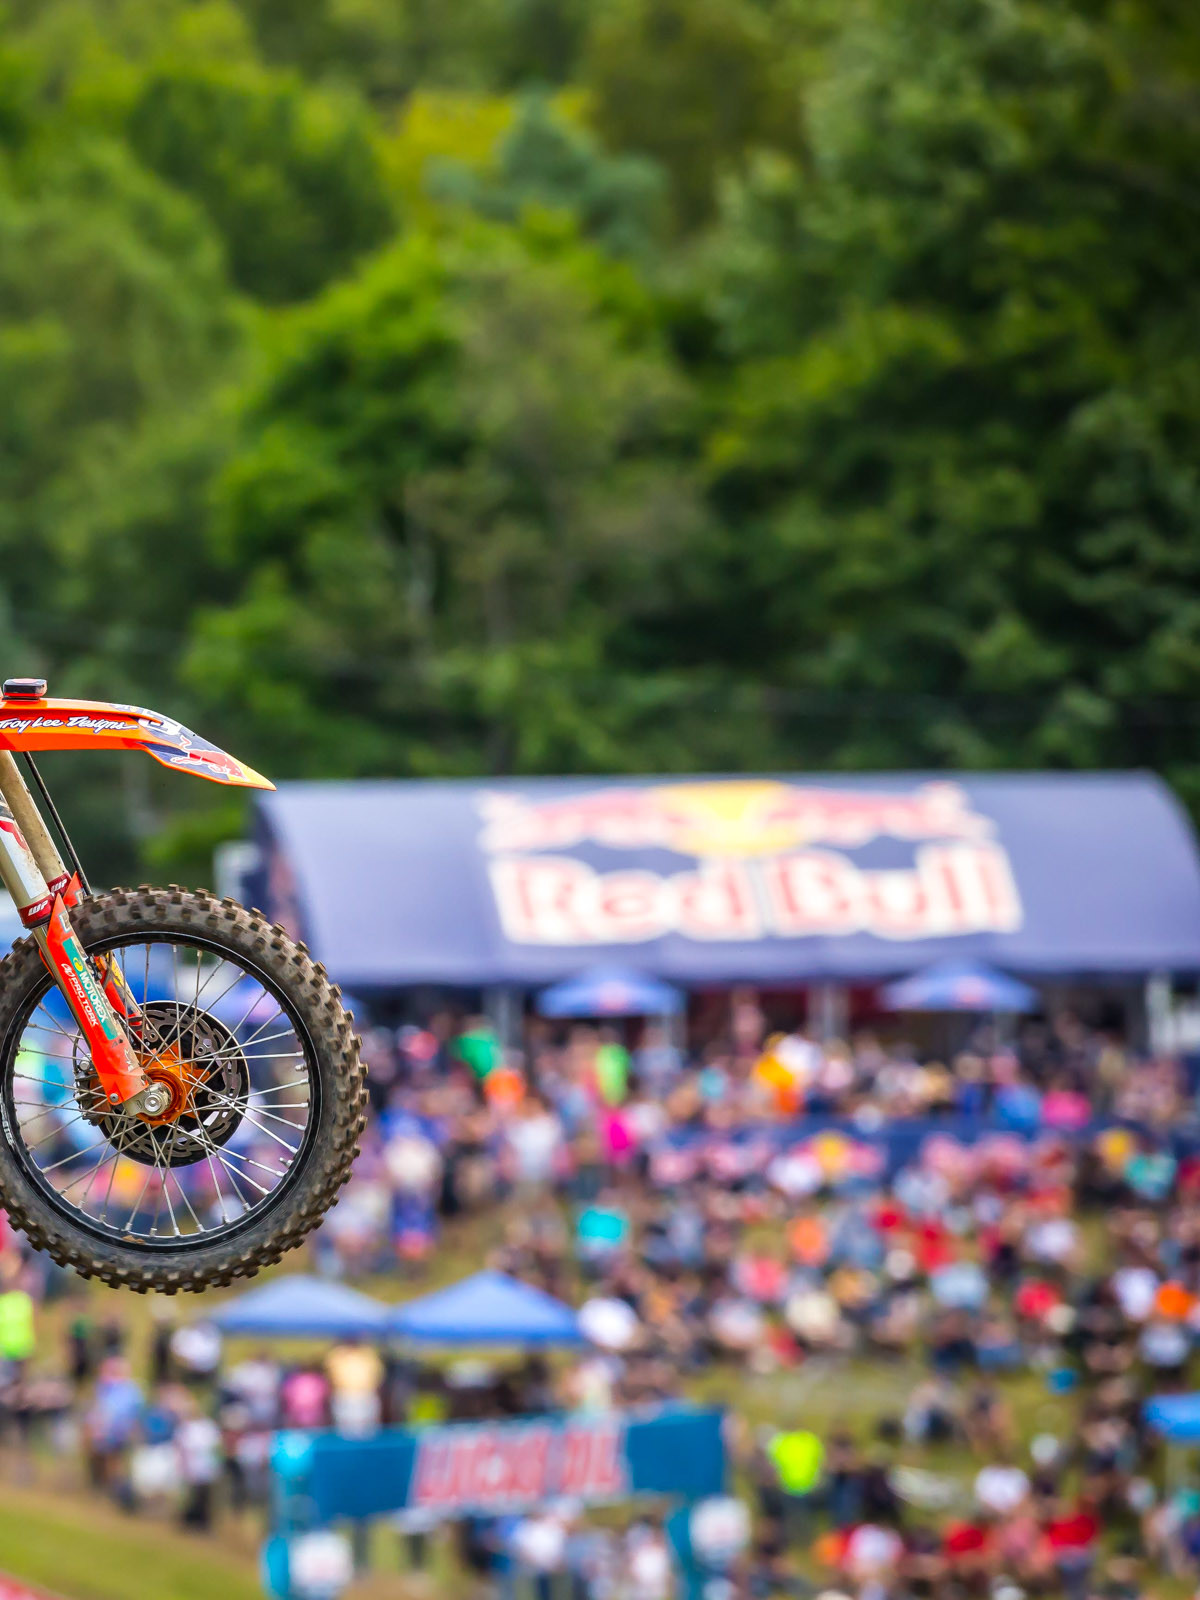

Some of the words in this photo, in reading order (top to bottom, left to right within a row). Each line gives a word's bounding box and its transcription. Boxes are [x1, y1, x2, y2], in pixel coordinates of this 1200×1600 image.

[31, 716, 64, 728] Lee
[65, 716, 139, 733] Designs
[50, 878, 68, 893] WP
[490, 854, 765, 945] Red
[762, 842, 1024, 942] Bull
[27, 899, 49, 917] WP
[71, 976, 85, 998] PRO
[82, 1000, 99, 1027] TORK
[79, 970, 108, 1023] MOTOREX
